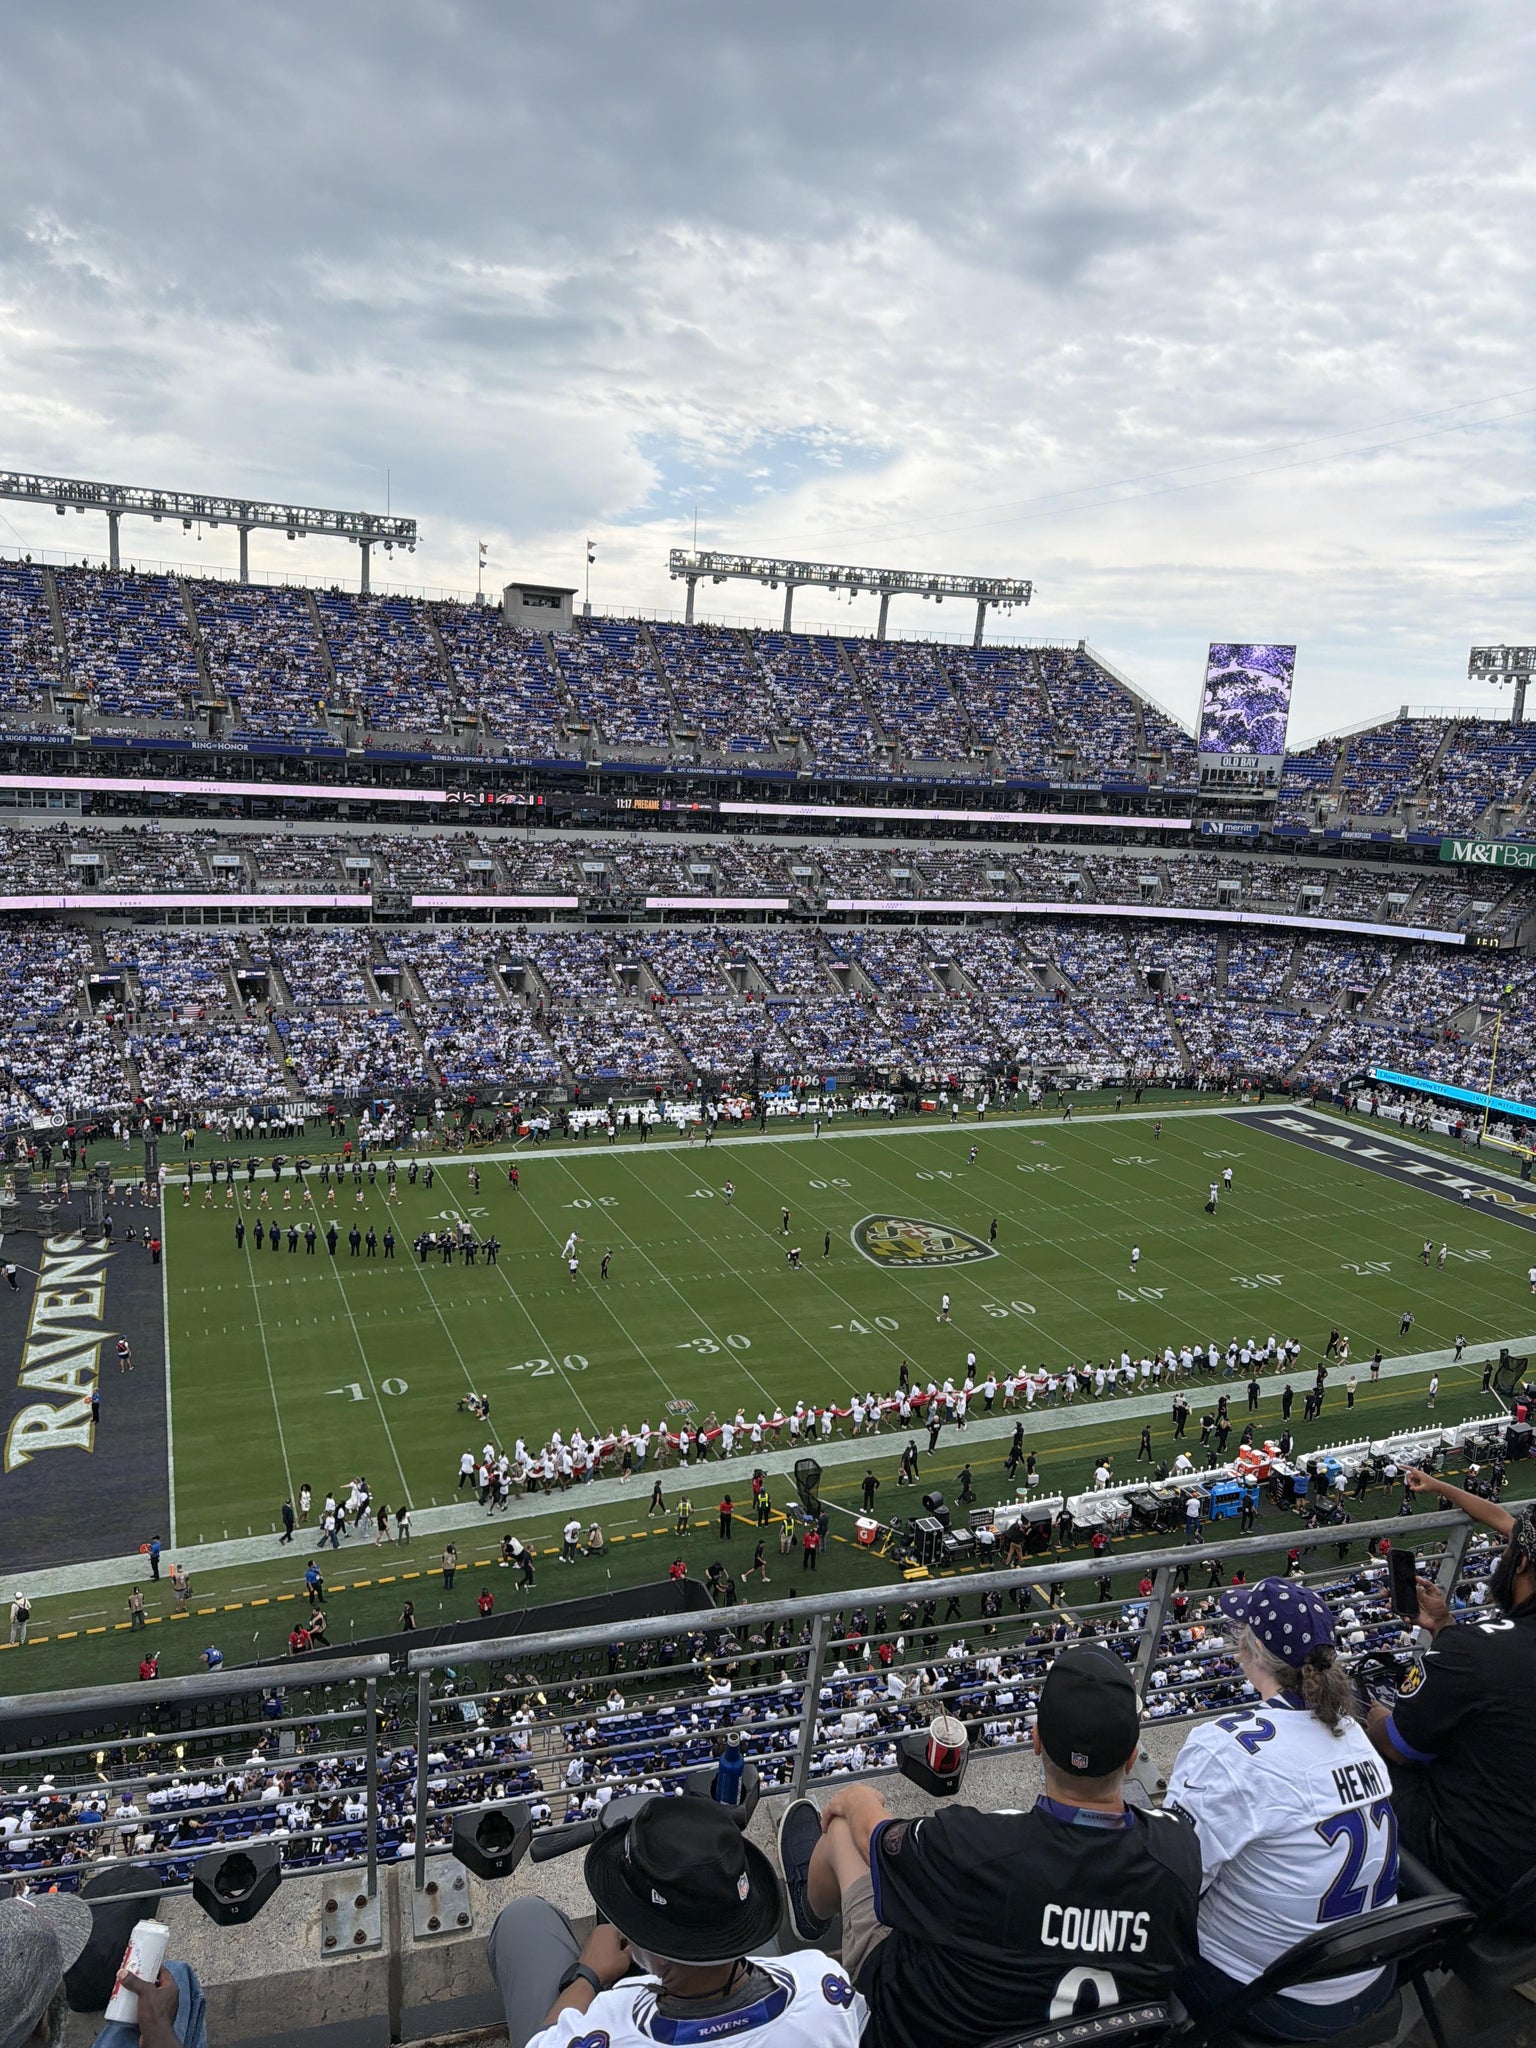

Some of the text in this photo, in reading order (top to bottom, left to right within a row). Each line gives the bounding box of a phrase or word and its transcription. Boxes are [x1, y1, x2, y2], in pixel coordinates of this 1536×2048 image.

[191, 742, 212, 750] RING
[218, 743, 249, 751] HONOR
[1223, 757, 1257, 767] OLD BAY
[616, 798, 660, 811] 11:17 PREGAME
[1224, 824, 1252, 832] merritt
[1451, 841, 1503, 864] M&T
[808, 1177, 853, 1190] 50
[915, 1169, 954, 1182] 40
[572, 1195, 620, 1210] 30
[438, 1206, 490, 1222] 20
[888, 1249, 985, 1265] RAVENS
[1341, 1259, 1390, 1277] 20
[1230, 1272, 1281, 1290] 30
[1117, 1285, 1165, 1303] 40
[980, 1300, 1037, 1319] 50
[848, 1315, 900, 1335] 40
[692, 1333, 751, 1354] 30
[4, 1232, 121, 1474] RAVENS
[524, 1354, 589, 1377] 20
[344, 1377, 409, 1402] 10
[1478, 1619, 1515, 1634] 2
[1214, 1710, 1277, 1756] 22
[1331, 1759, 1386, 1806] HENRY
[586, 1807, 598, 1818] 28
[311, 1841, 321, 1853] 14
[1313, 1797, 1399, 1923] 22
[1041, 1903, 1151, 1953] COUNTS
[820, 1972, 856, 2010] 8
[696, 2017, 750, 2036] RAVENS
